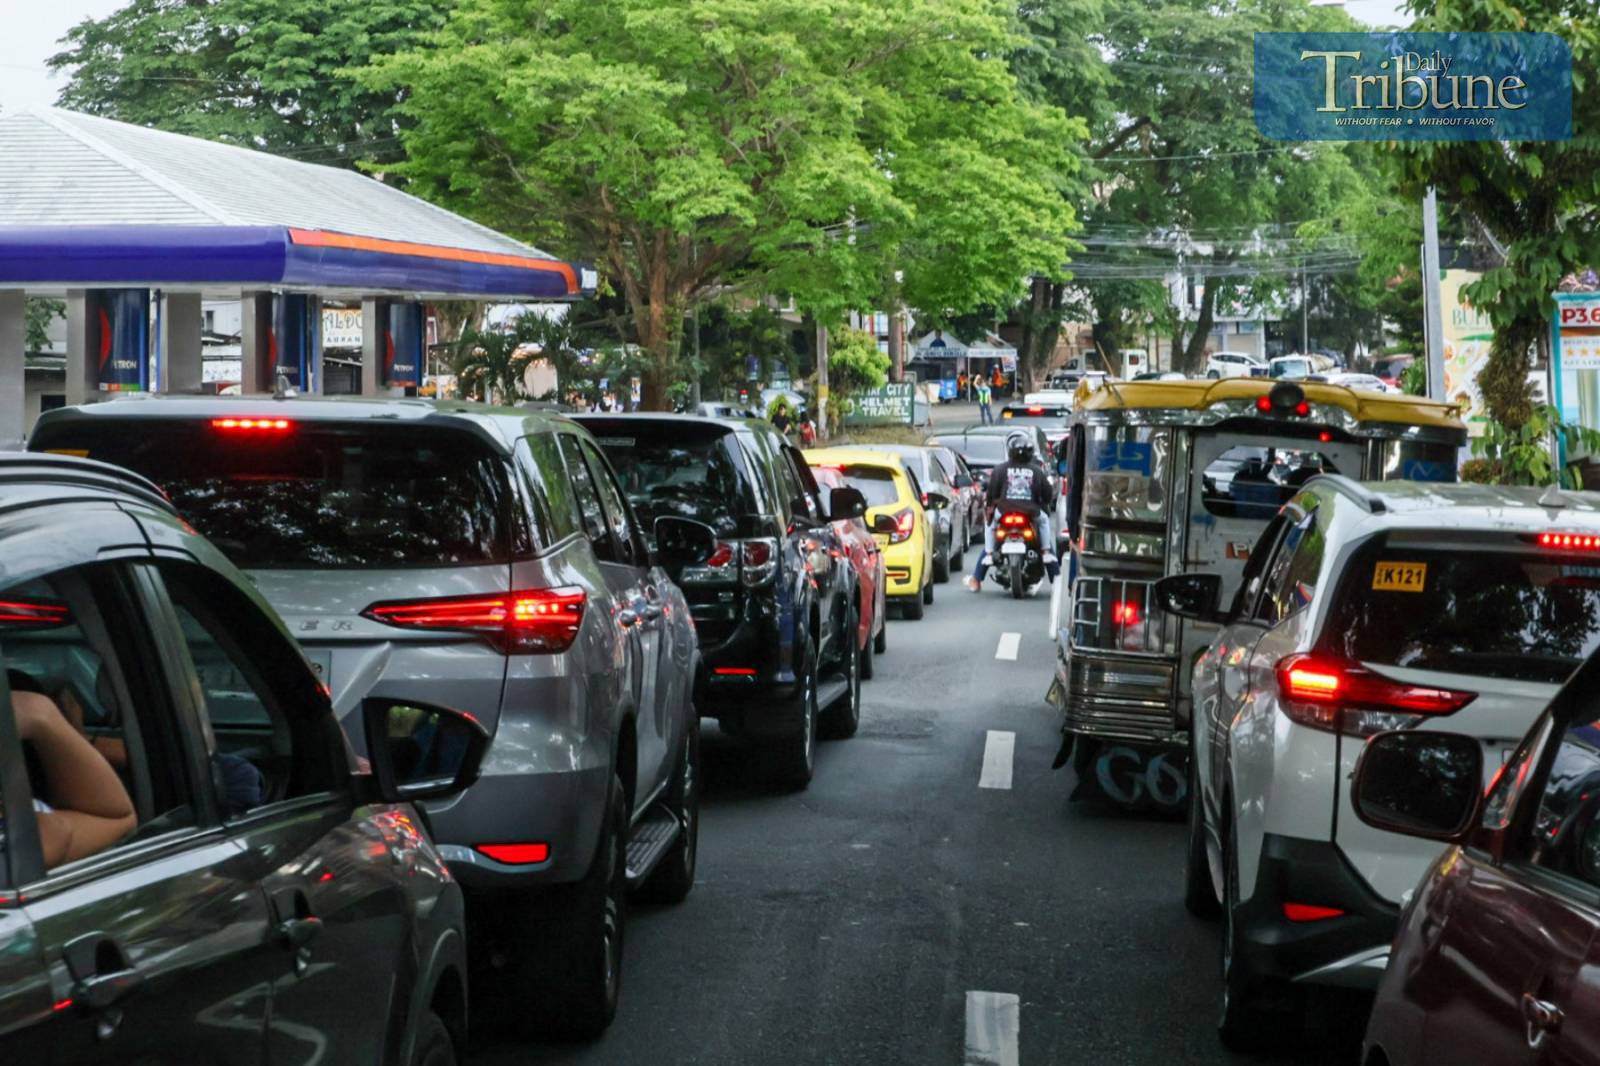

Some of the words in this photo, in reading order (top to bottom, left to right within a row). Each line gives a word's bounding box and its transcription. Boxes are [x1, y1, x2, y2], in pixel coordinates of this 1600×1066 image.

[886, 383, 911, 396] CITY
[858, 397, 911, 407] HELMET
[862, 406, 909, 416] TRAVEL
[1384, 568, 1423, 584] K121
